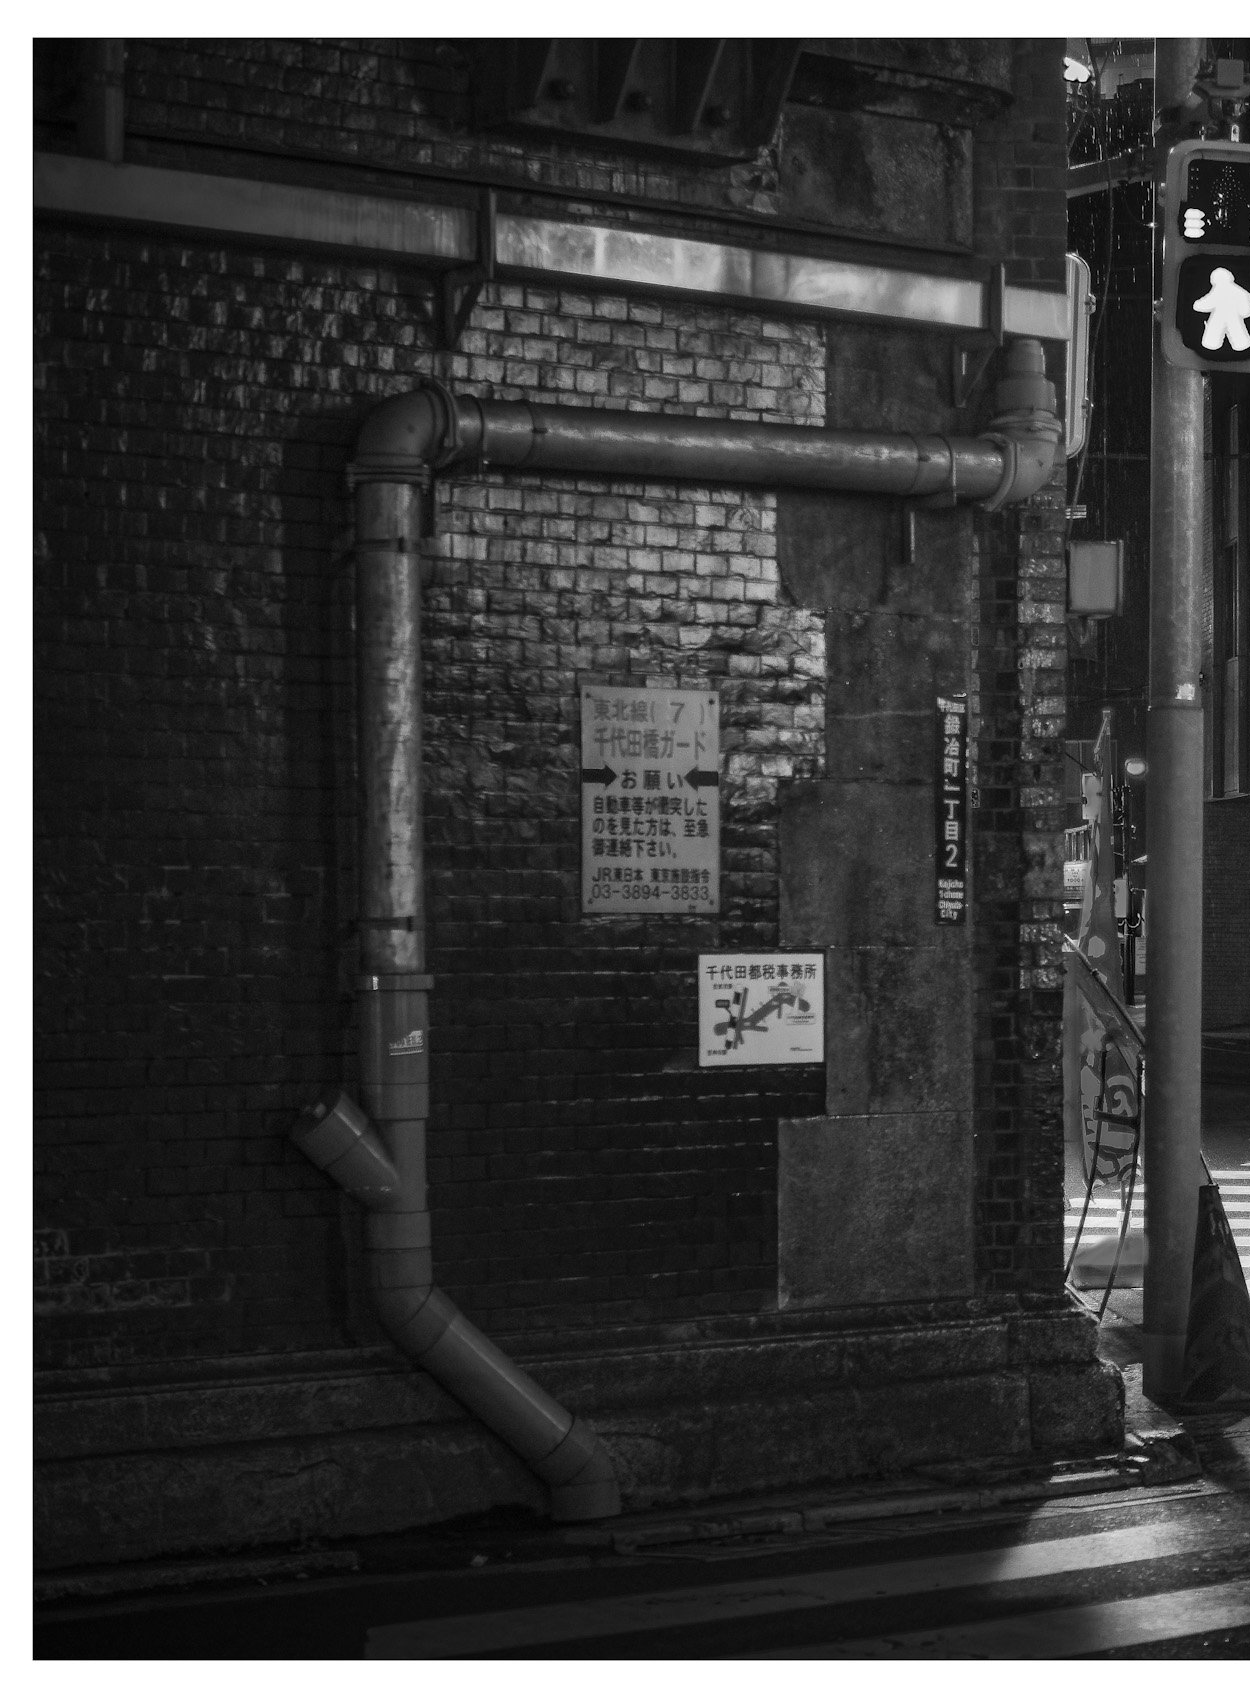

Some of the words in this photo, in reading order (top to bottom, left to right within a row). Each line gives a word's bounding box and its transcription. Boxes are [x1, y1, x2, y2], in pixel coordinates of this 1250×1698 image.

[621, 768, 683, 790] お願い
[592, 884, 709, 900] 03-3894-3833
[706, 963, 816, 980] 千代田都税事務所
